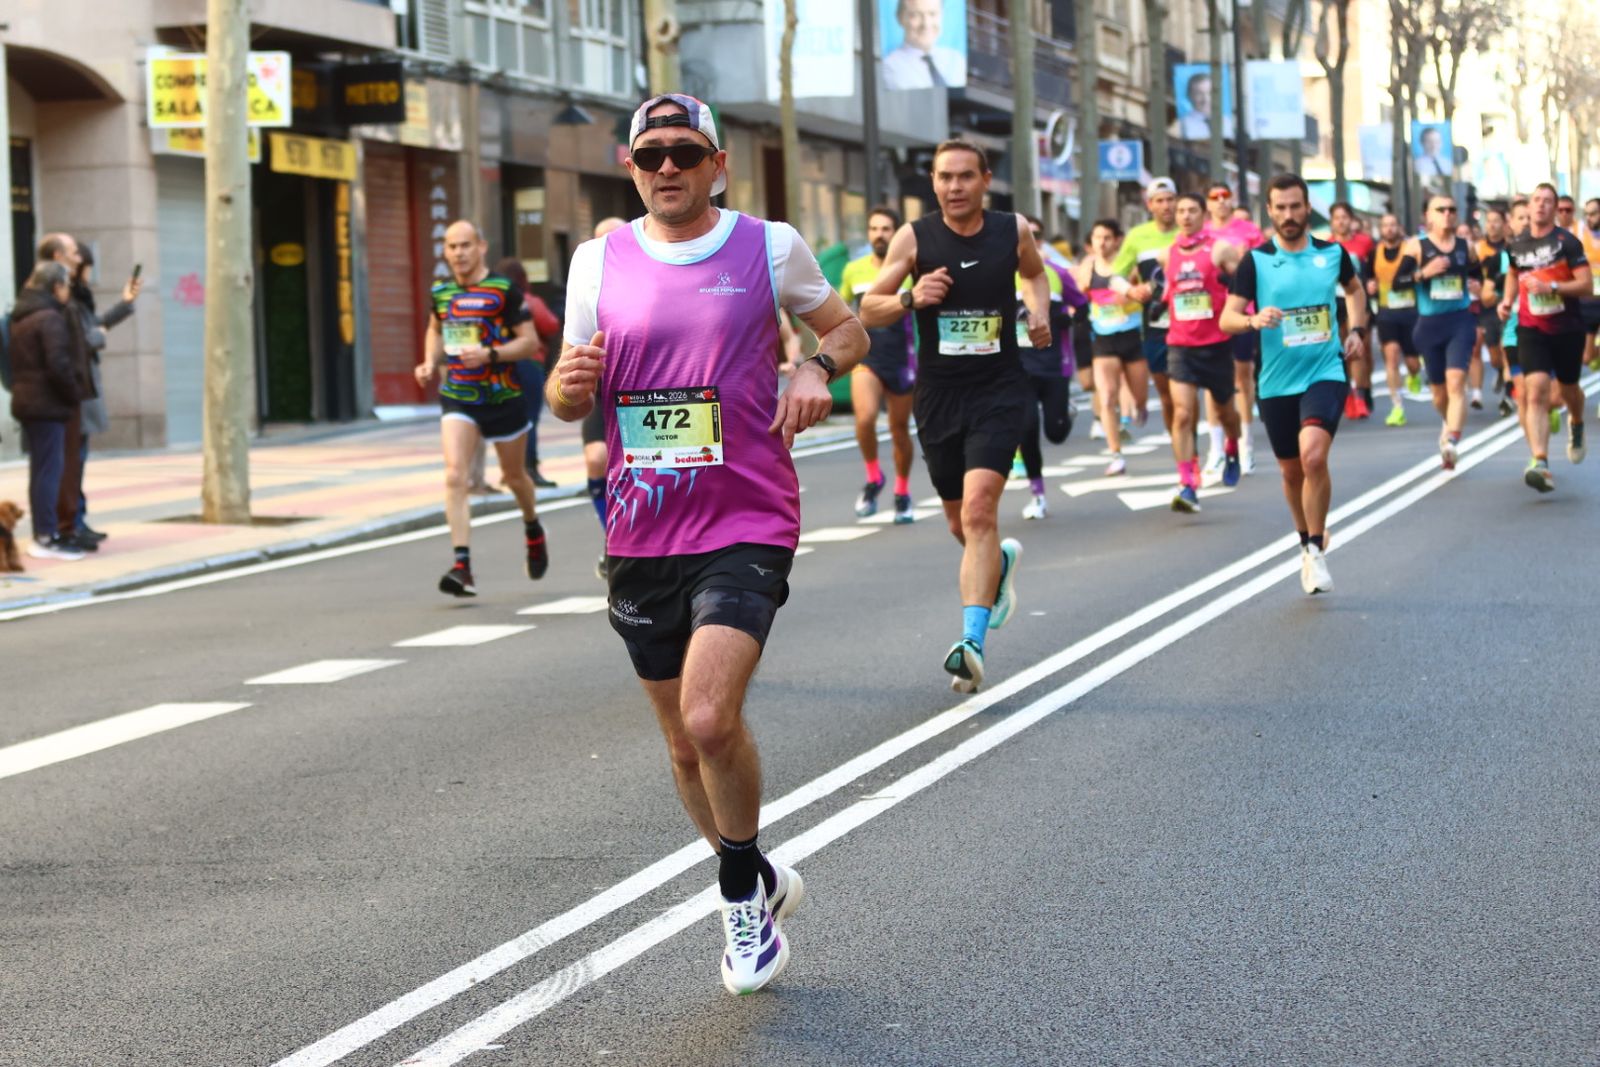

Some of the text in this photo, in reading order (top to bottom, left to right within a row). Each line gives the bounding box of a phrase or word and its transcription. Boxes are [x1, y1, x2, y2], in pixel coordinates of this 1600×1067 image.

[155, 99, 276, 116] SALACA
[950, 320, 989, 333] 2271
[1295, 314, 1320, 328] 543
[668, 391, 688, 400] 2026
[642, 408, 690, 429] 472
